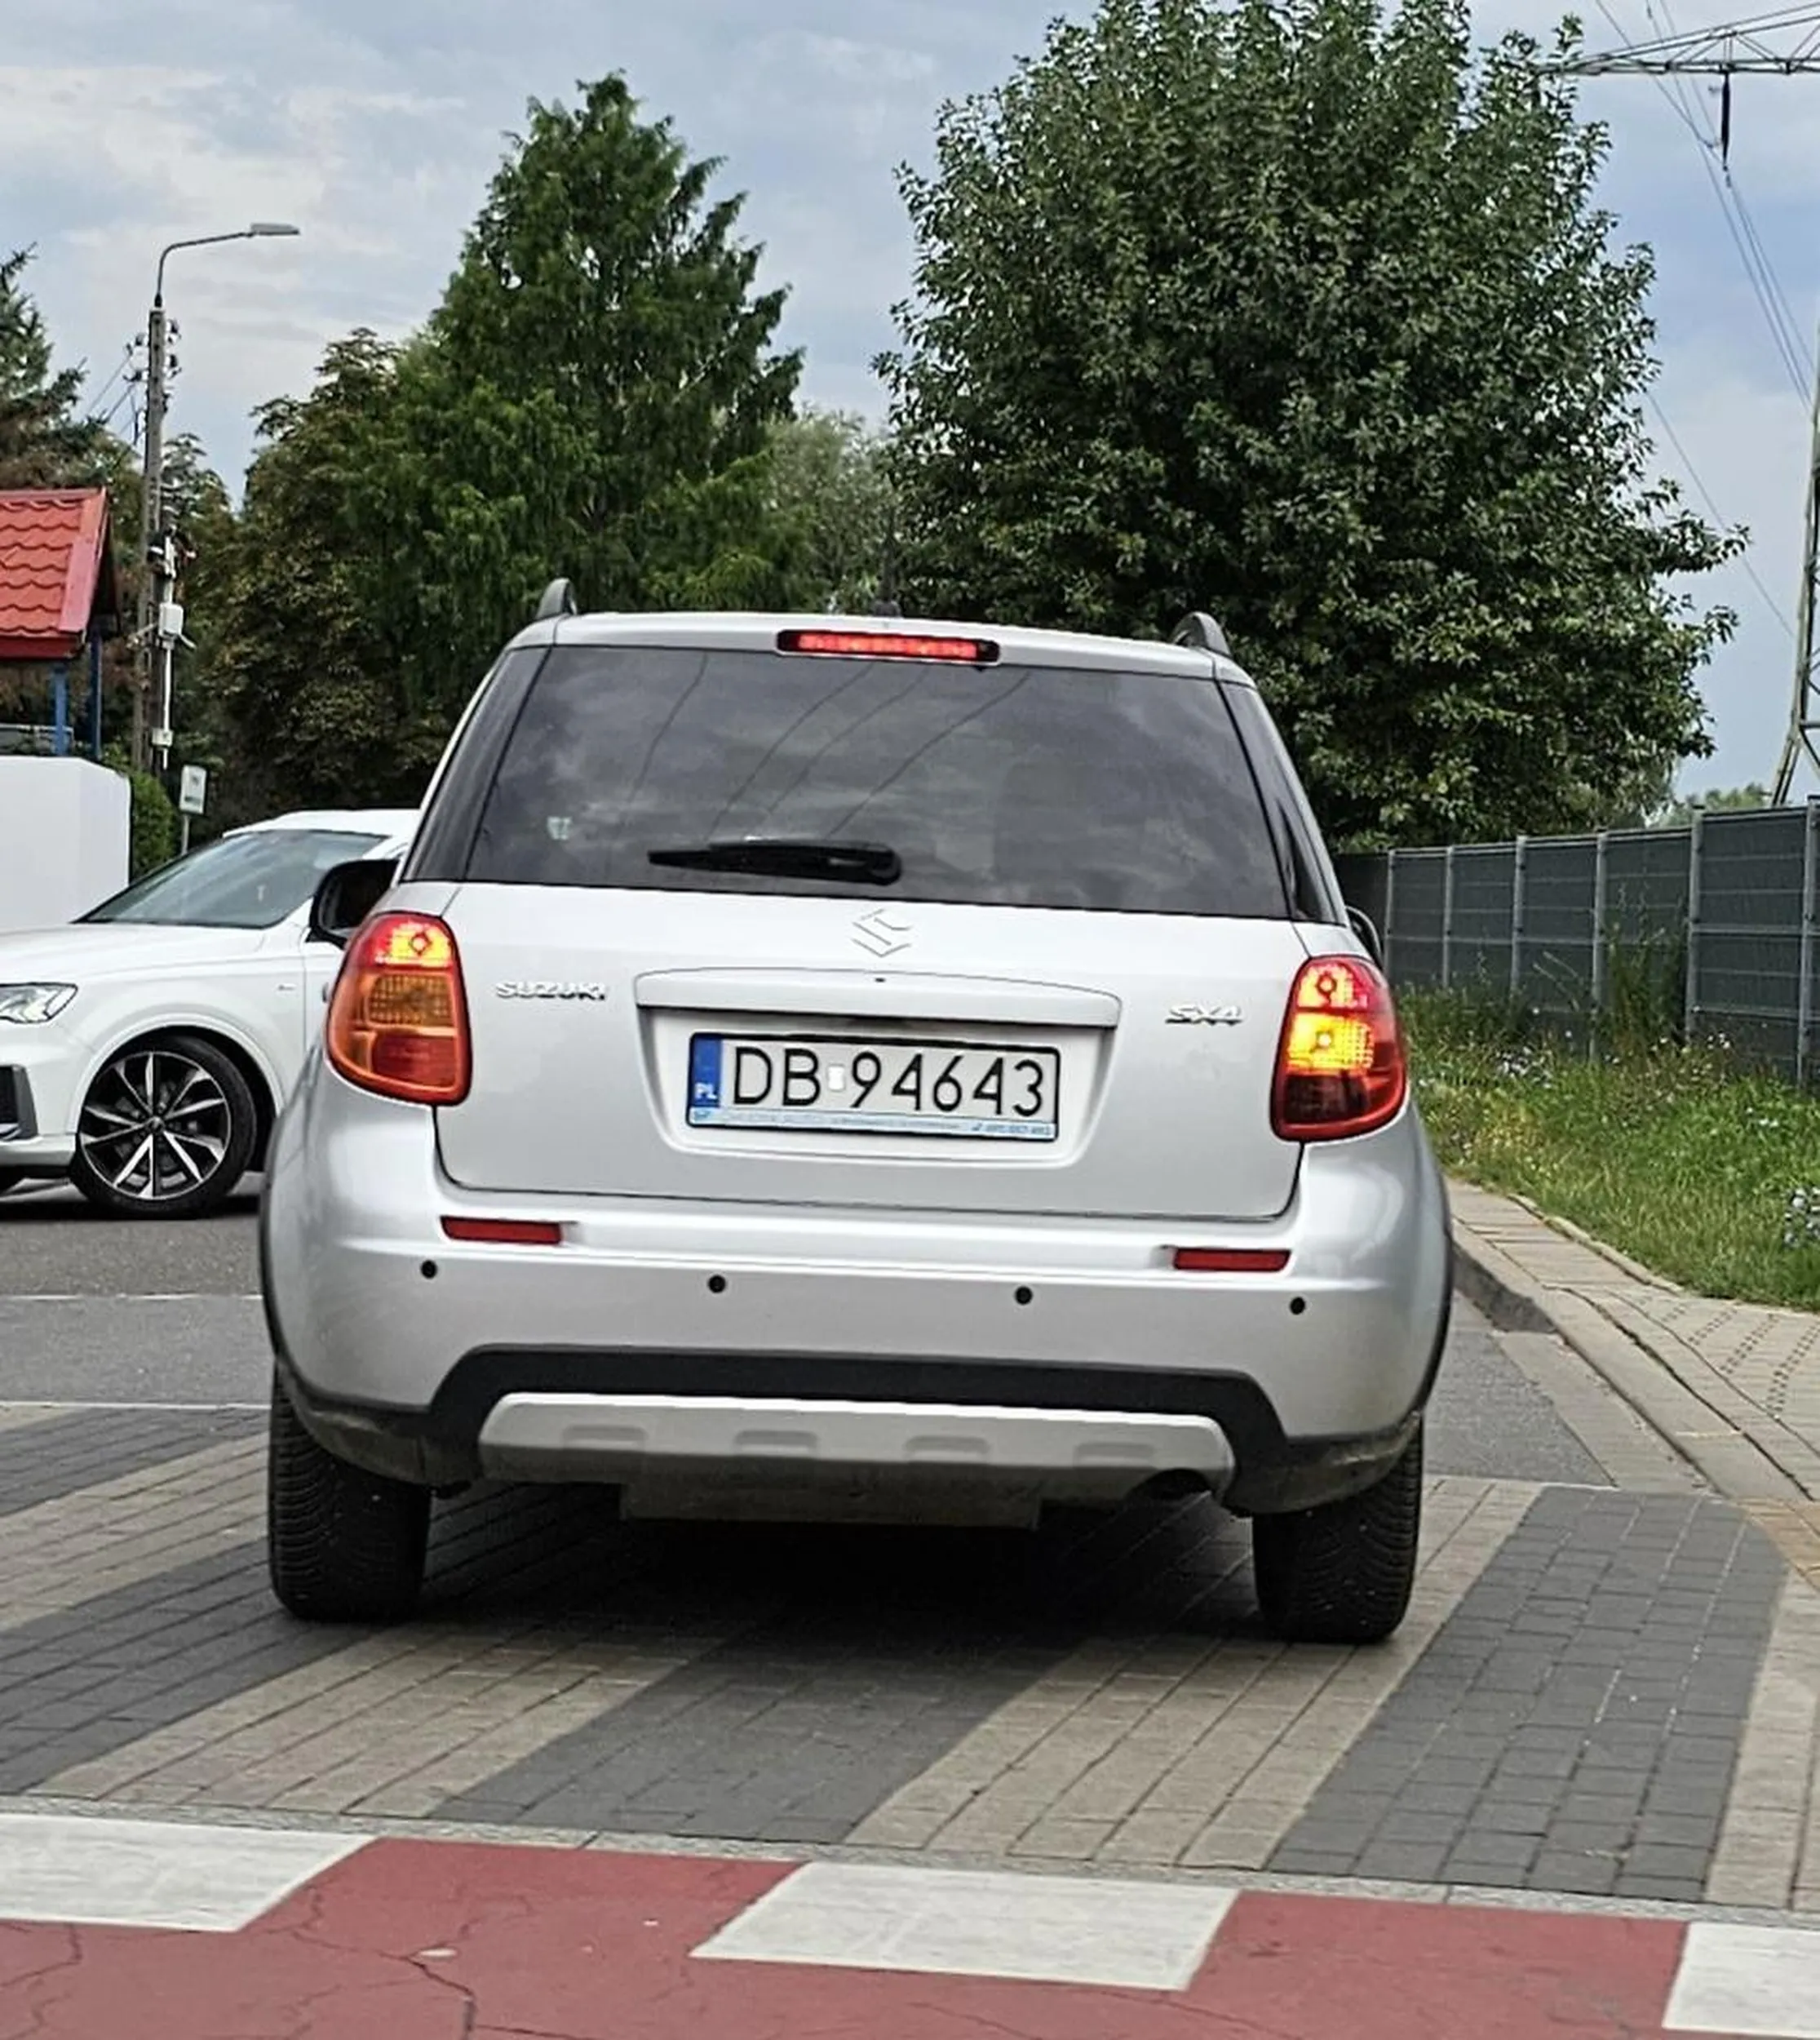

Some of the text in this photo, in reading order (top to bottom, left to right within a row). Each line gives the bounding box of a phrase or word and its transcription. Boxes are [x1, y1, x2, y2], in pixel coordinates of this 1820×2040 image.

[496, 982, 606, 1000] SUZUKI
[1165, 1004, 1242, 1026] SX4
[733, 1046, 1043, 1117] DB 94643
